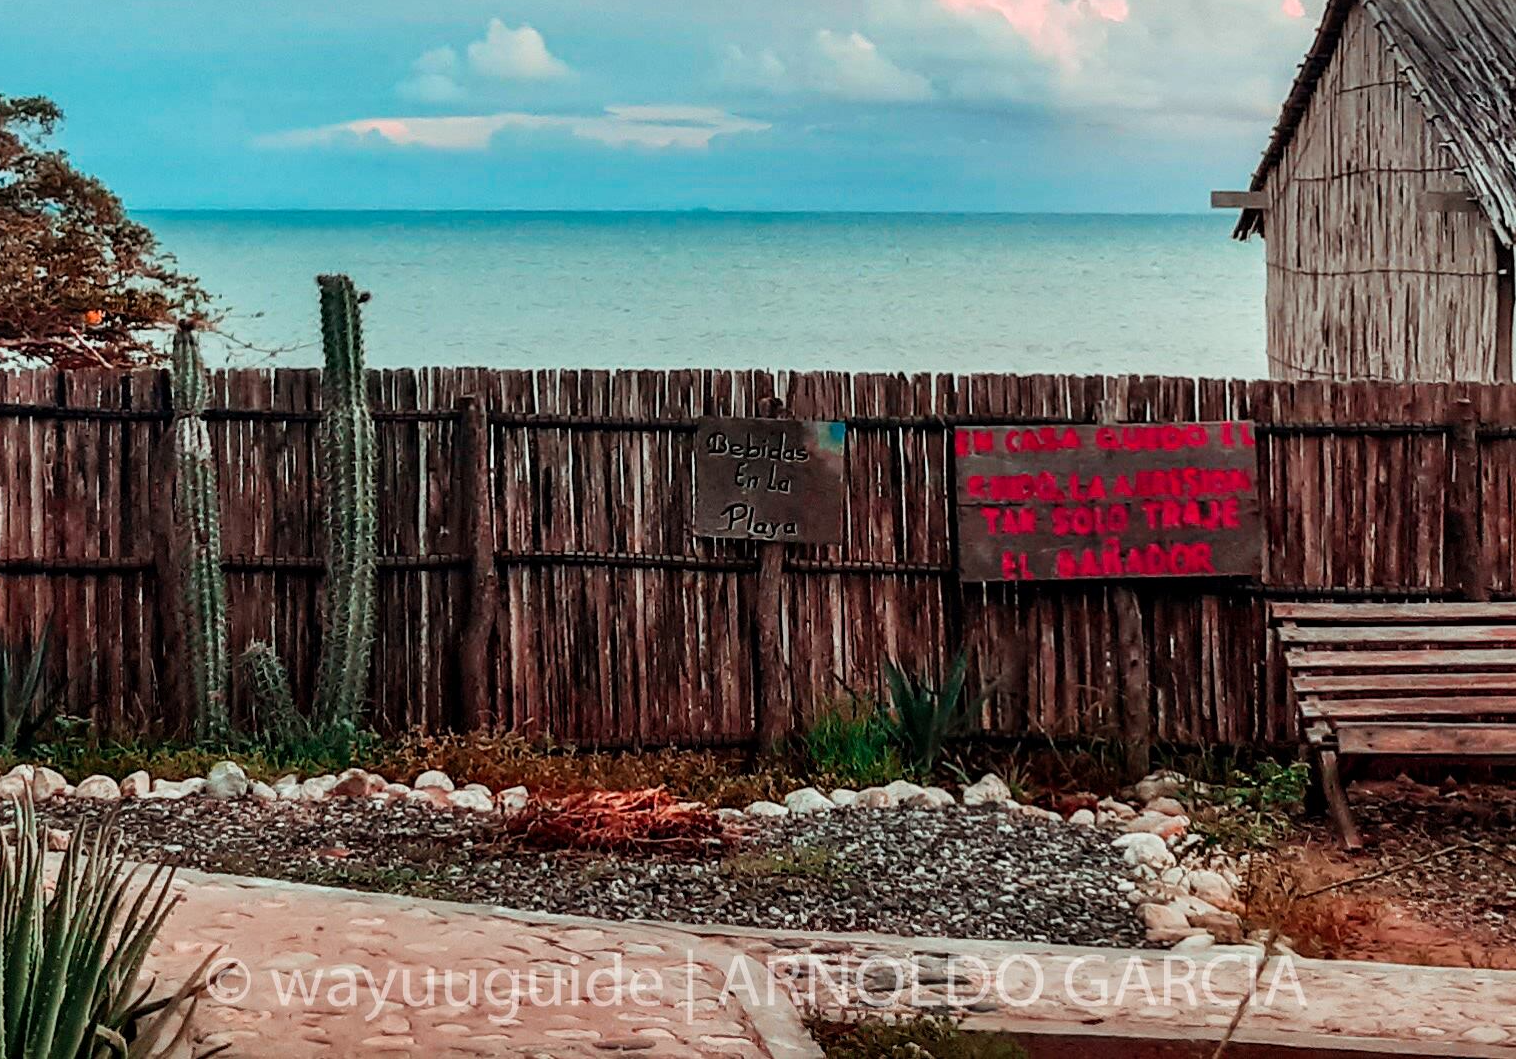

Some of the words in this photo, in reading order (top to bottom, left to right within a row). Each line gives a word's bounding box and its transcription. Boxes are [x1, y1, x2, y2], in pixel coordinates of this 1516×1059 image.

[707, 431, 810, 463] Bebidas
[955, 428, 994, 457] EN
[1005, 427, 1081, 452] CASA
[1095, 423, 1210, 451] QUEDO
[735, 462, 761, 489] En
[767, 463, 792, 494] La
[1068, 472, 1107, 501] LA
[720, 502, 798, 540] Playa
[980, 507, 1036, 535] TAN
[1051, 504, 1130, 536] SOLO
[1141, 498, 1240, 532] TRAJE
[1001, 550, 1035, 581] EL
[1057, 537, 1216, 578] BAÑADOR
